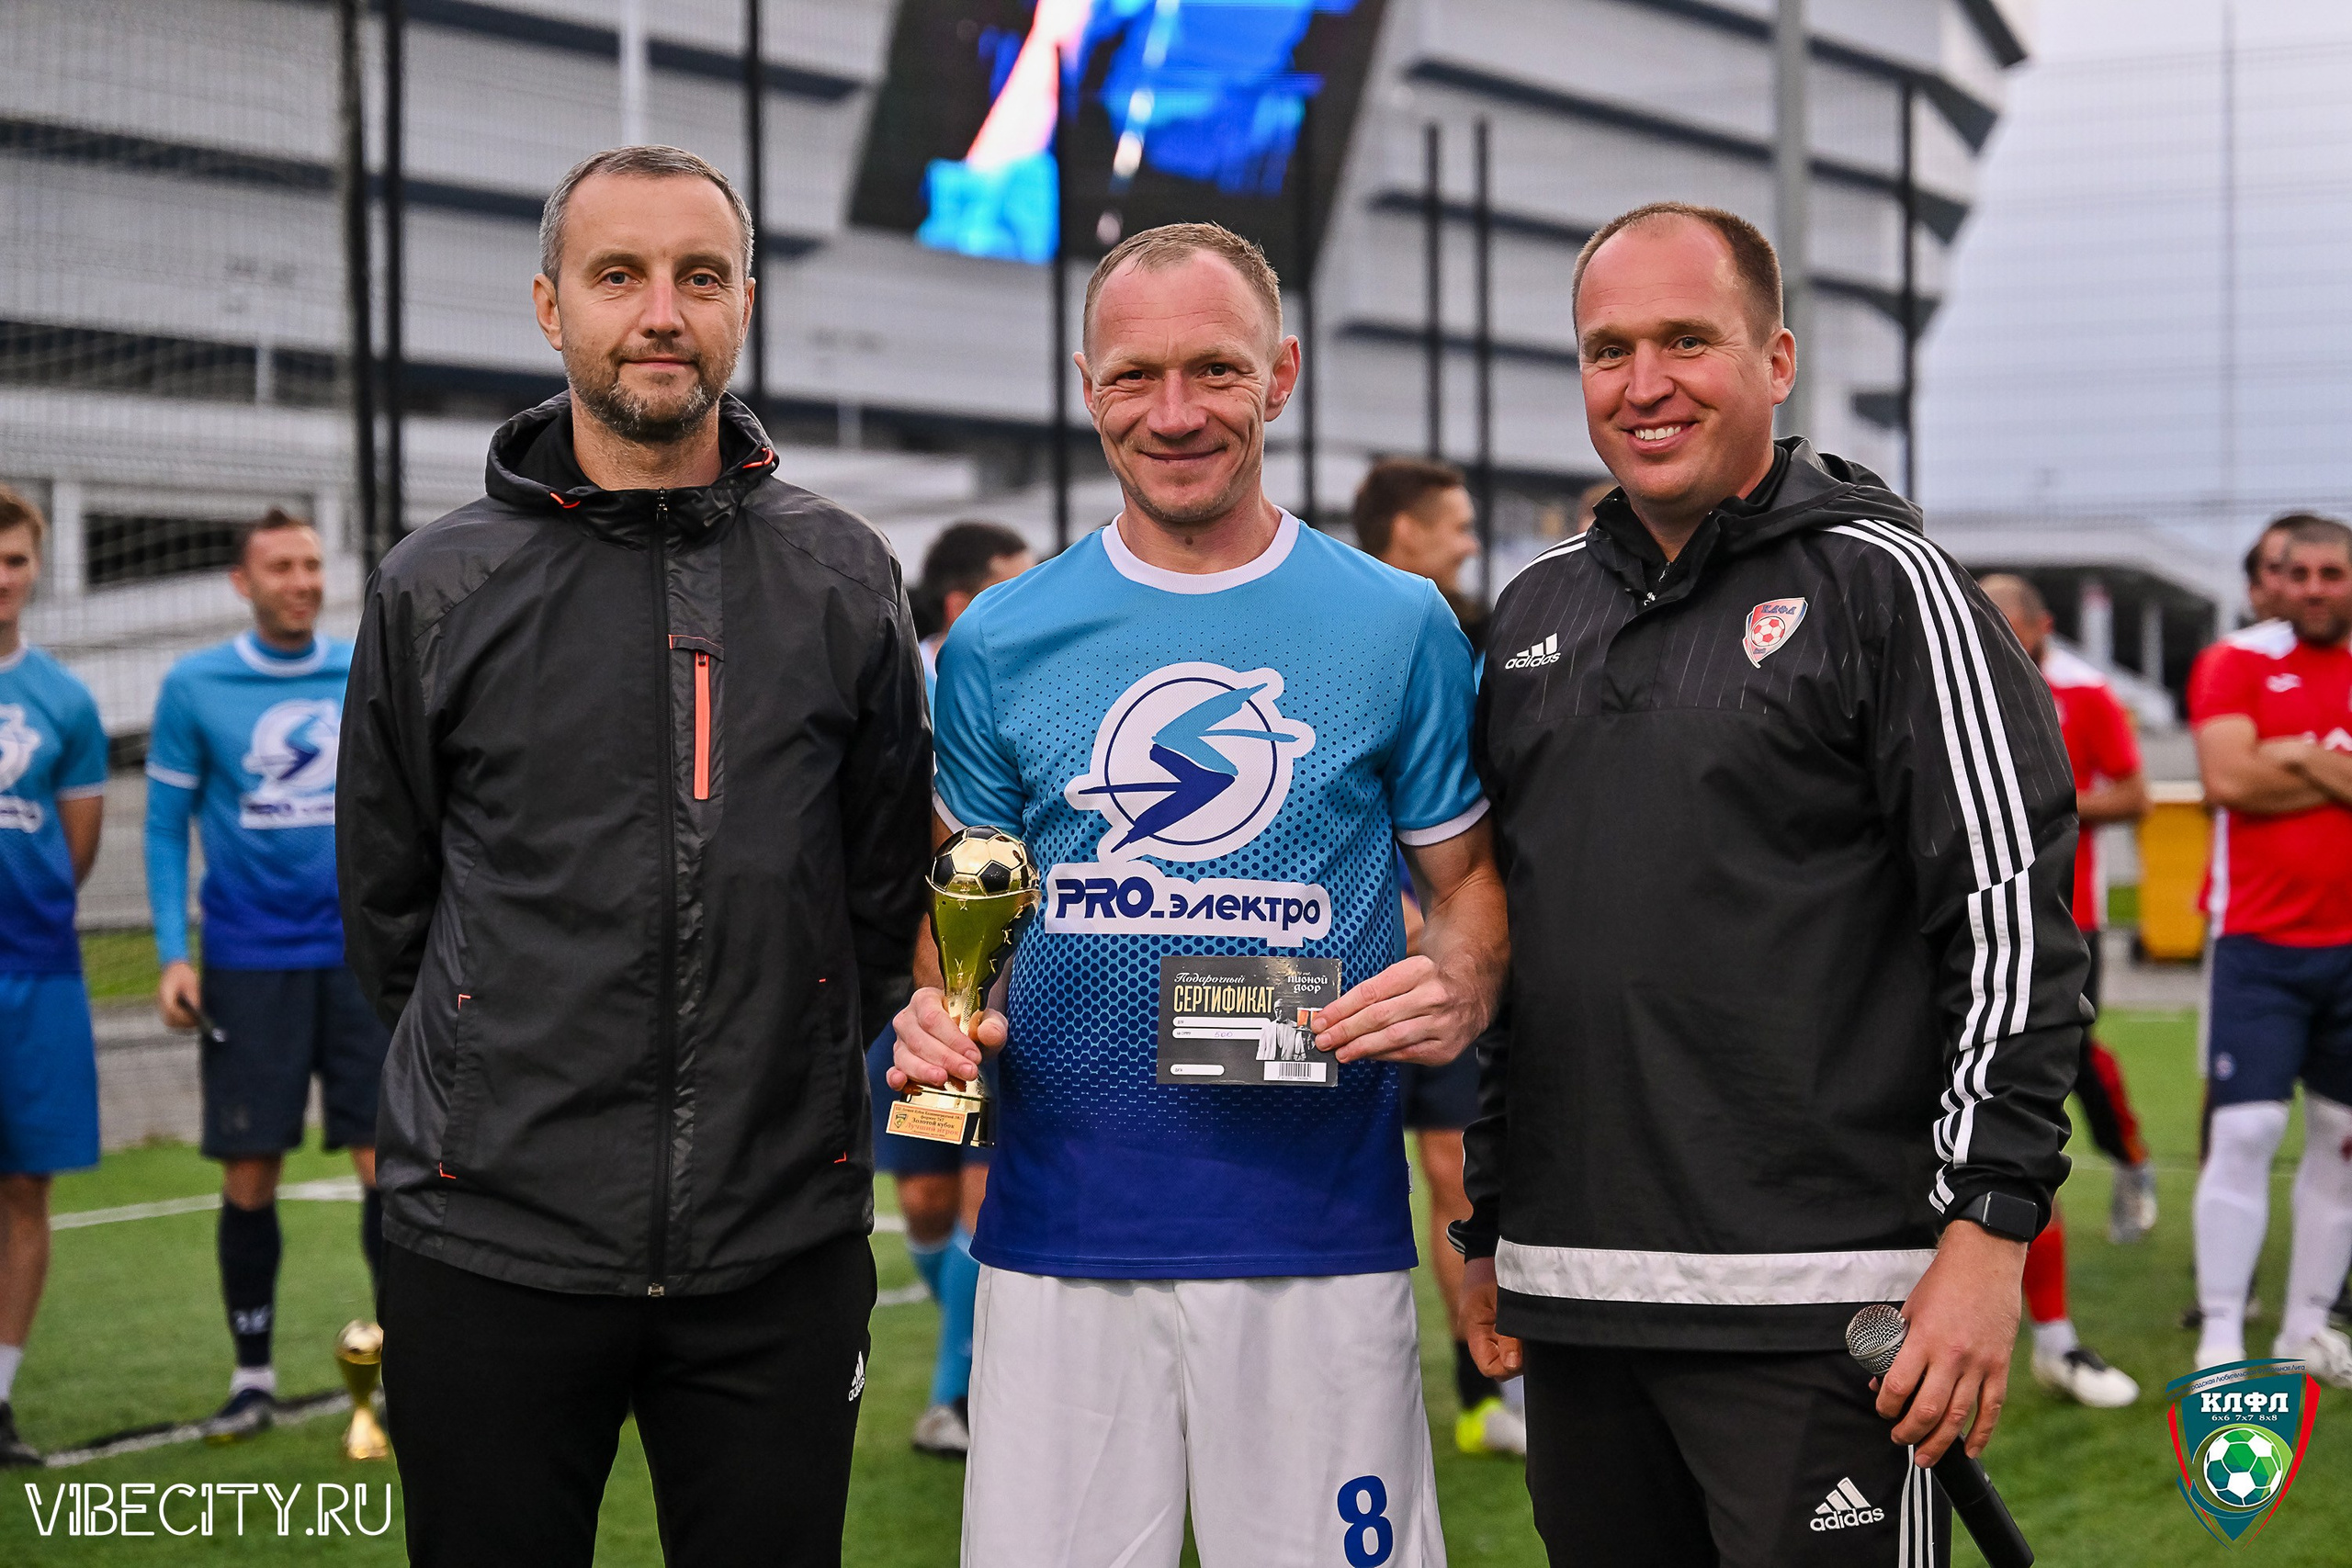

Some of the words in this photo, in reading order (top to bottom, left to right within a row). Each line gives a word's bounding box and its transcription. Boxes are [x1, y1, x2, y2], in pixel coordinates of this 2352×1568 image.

[1505, 652, 1562, 670] adidas
[1174, 972, 1245, 987] Подарочный
[1173, 985, 1275, 1014] СЕРТИФИКАТ
[905, 1122, 936, 1133] Лучший
[936, 1127, 959, 1136] игрок
[911, 1117, 936, 1126] Золотой
[937, 1121, 956, 1129] кубок
[1336, 1474, 1394, 1568] 8
[1809, 1507, 1885, 1532] adidas
